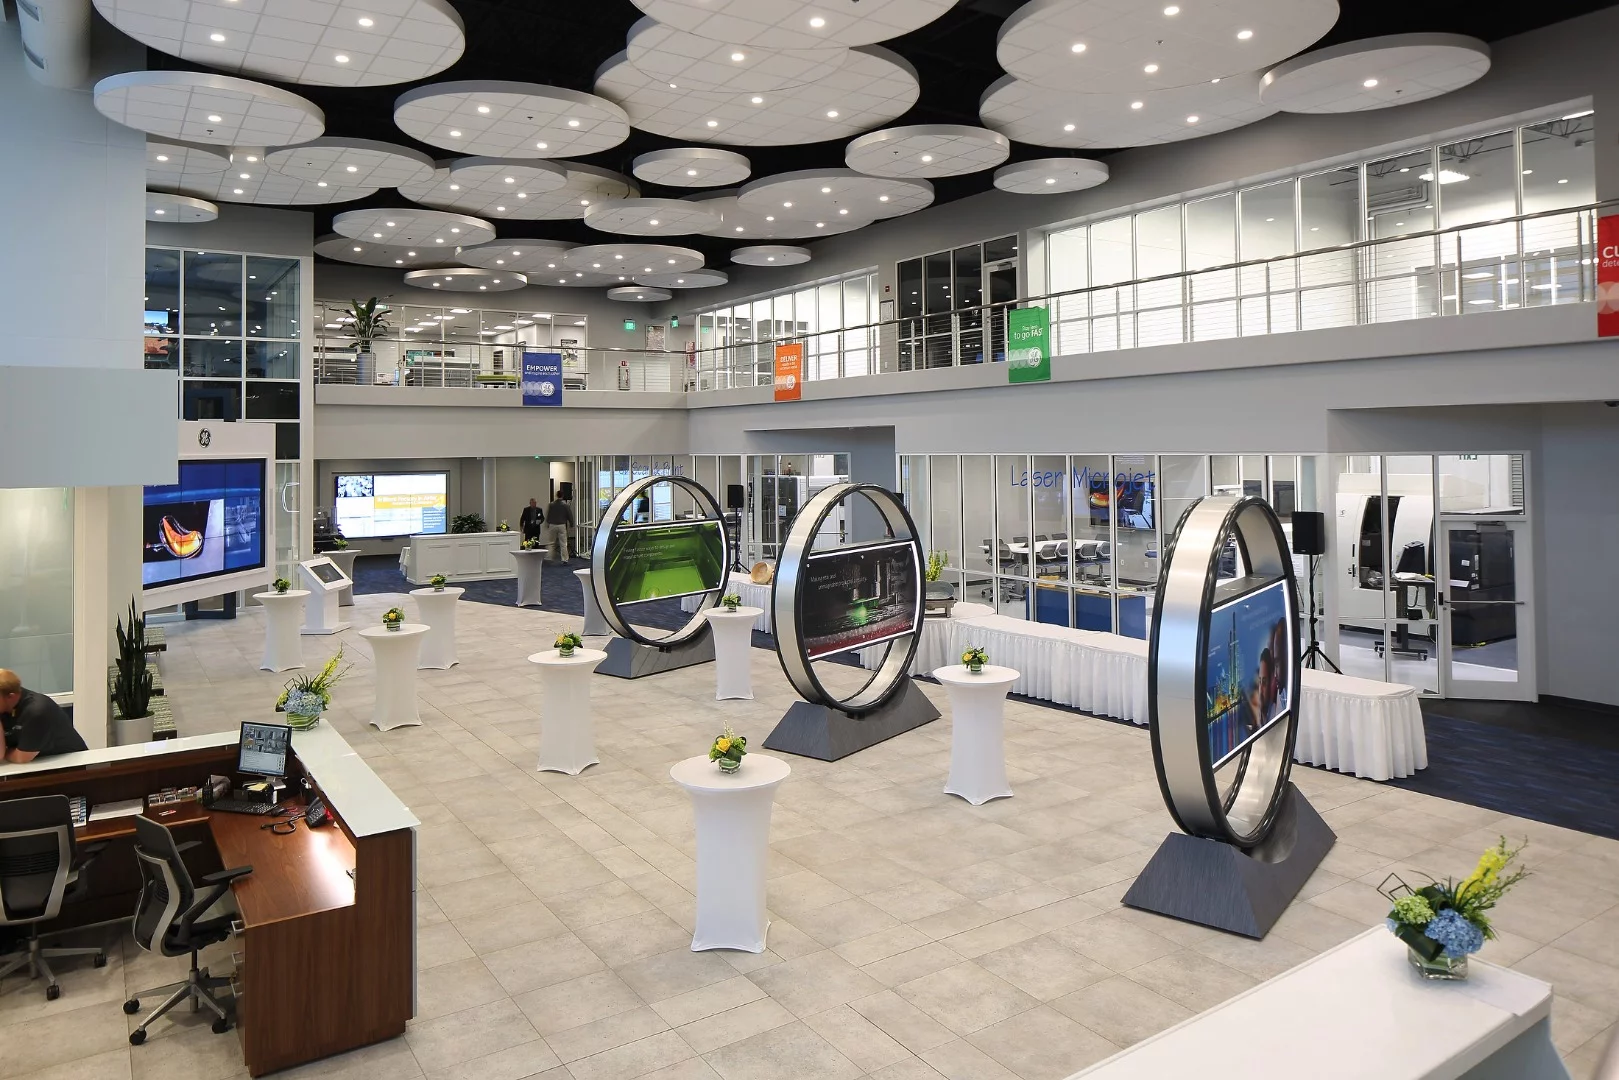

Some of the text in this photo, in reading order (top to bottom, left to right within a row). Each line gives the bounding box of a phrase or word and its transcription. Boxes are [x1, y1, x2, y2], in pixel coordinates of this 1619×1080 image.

[1014, 327, 1043, 340] to go FAS
[526, 364, 558, 372] EMPOWER
[1011, 465, 1156, 493] Laser Microjet
